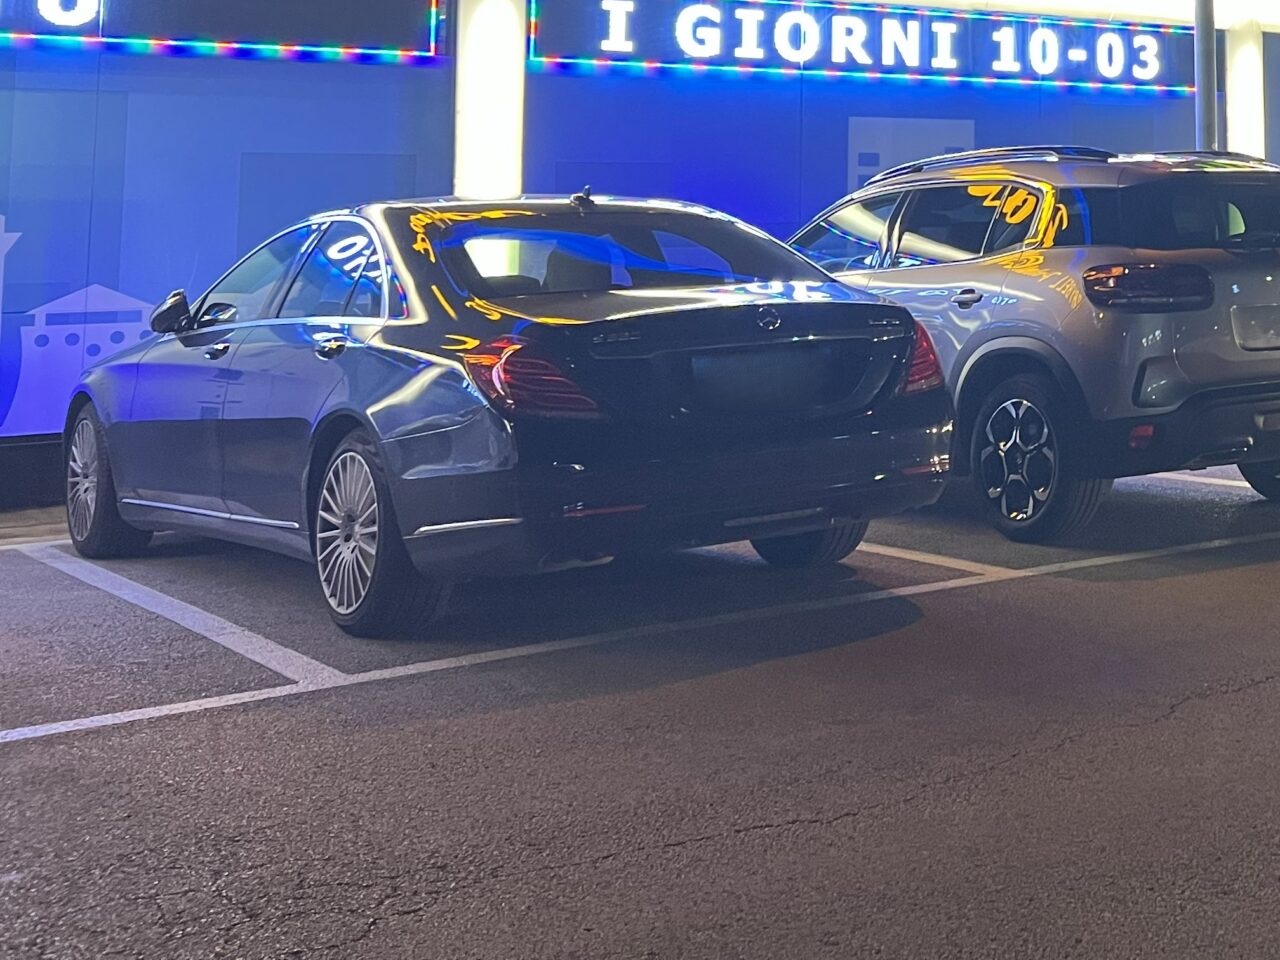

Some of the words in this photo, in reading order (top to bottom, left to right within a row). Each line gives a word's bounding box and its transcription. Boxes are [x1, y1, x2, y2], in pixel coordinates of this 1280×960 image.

[600, 0, 635, 53] I
[675, 4, 958, 70] GIORNI
[992, 27, 1161, 81] 10-03
